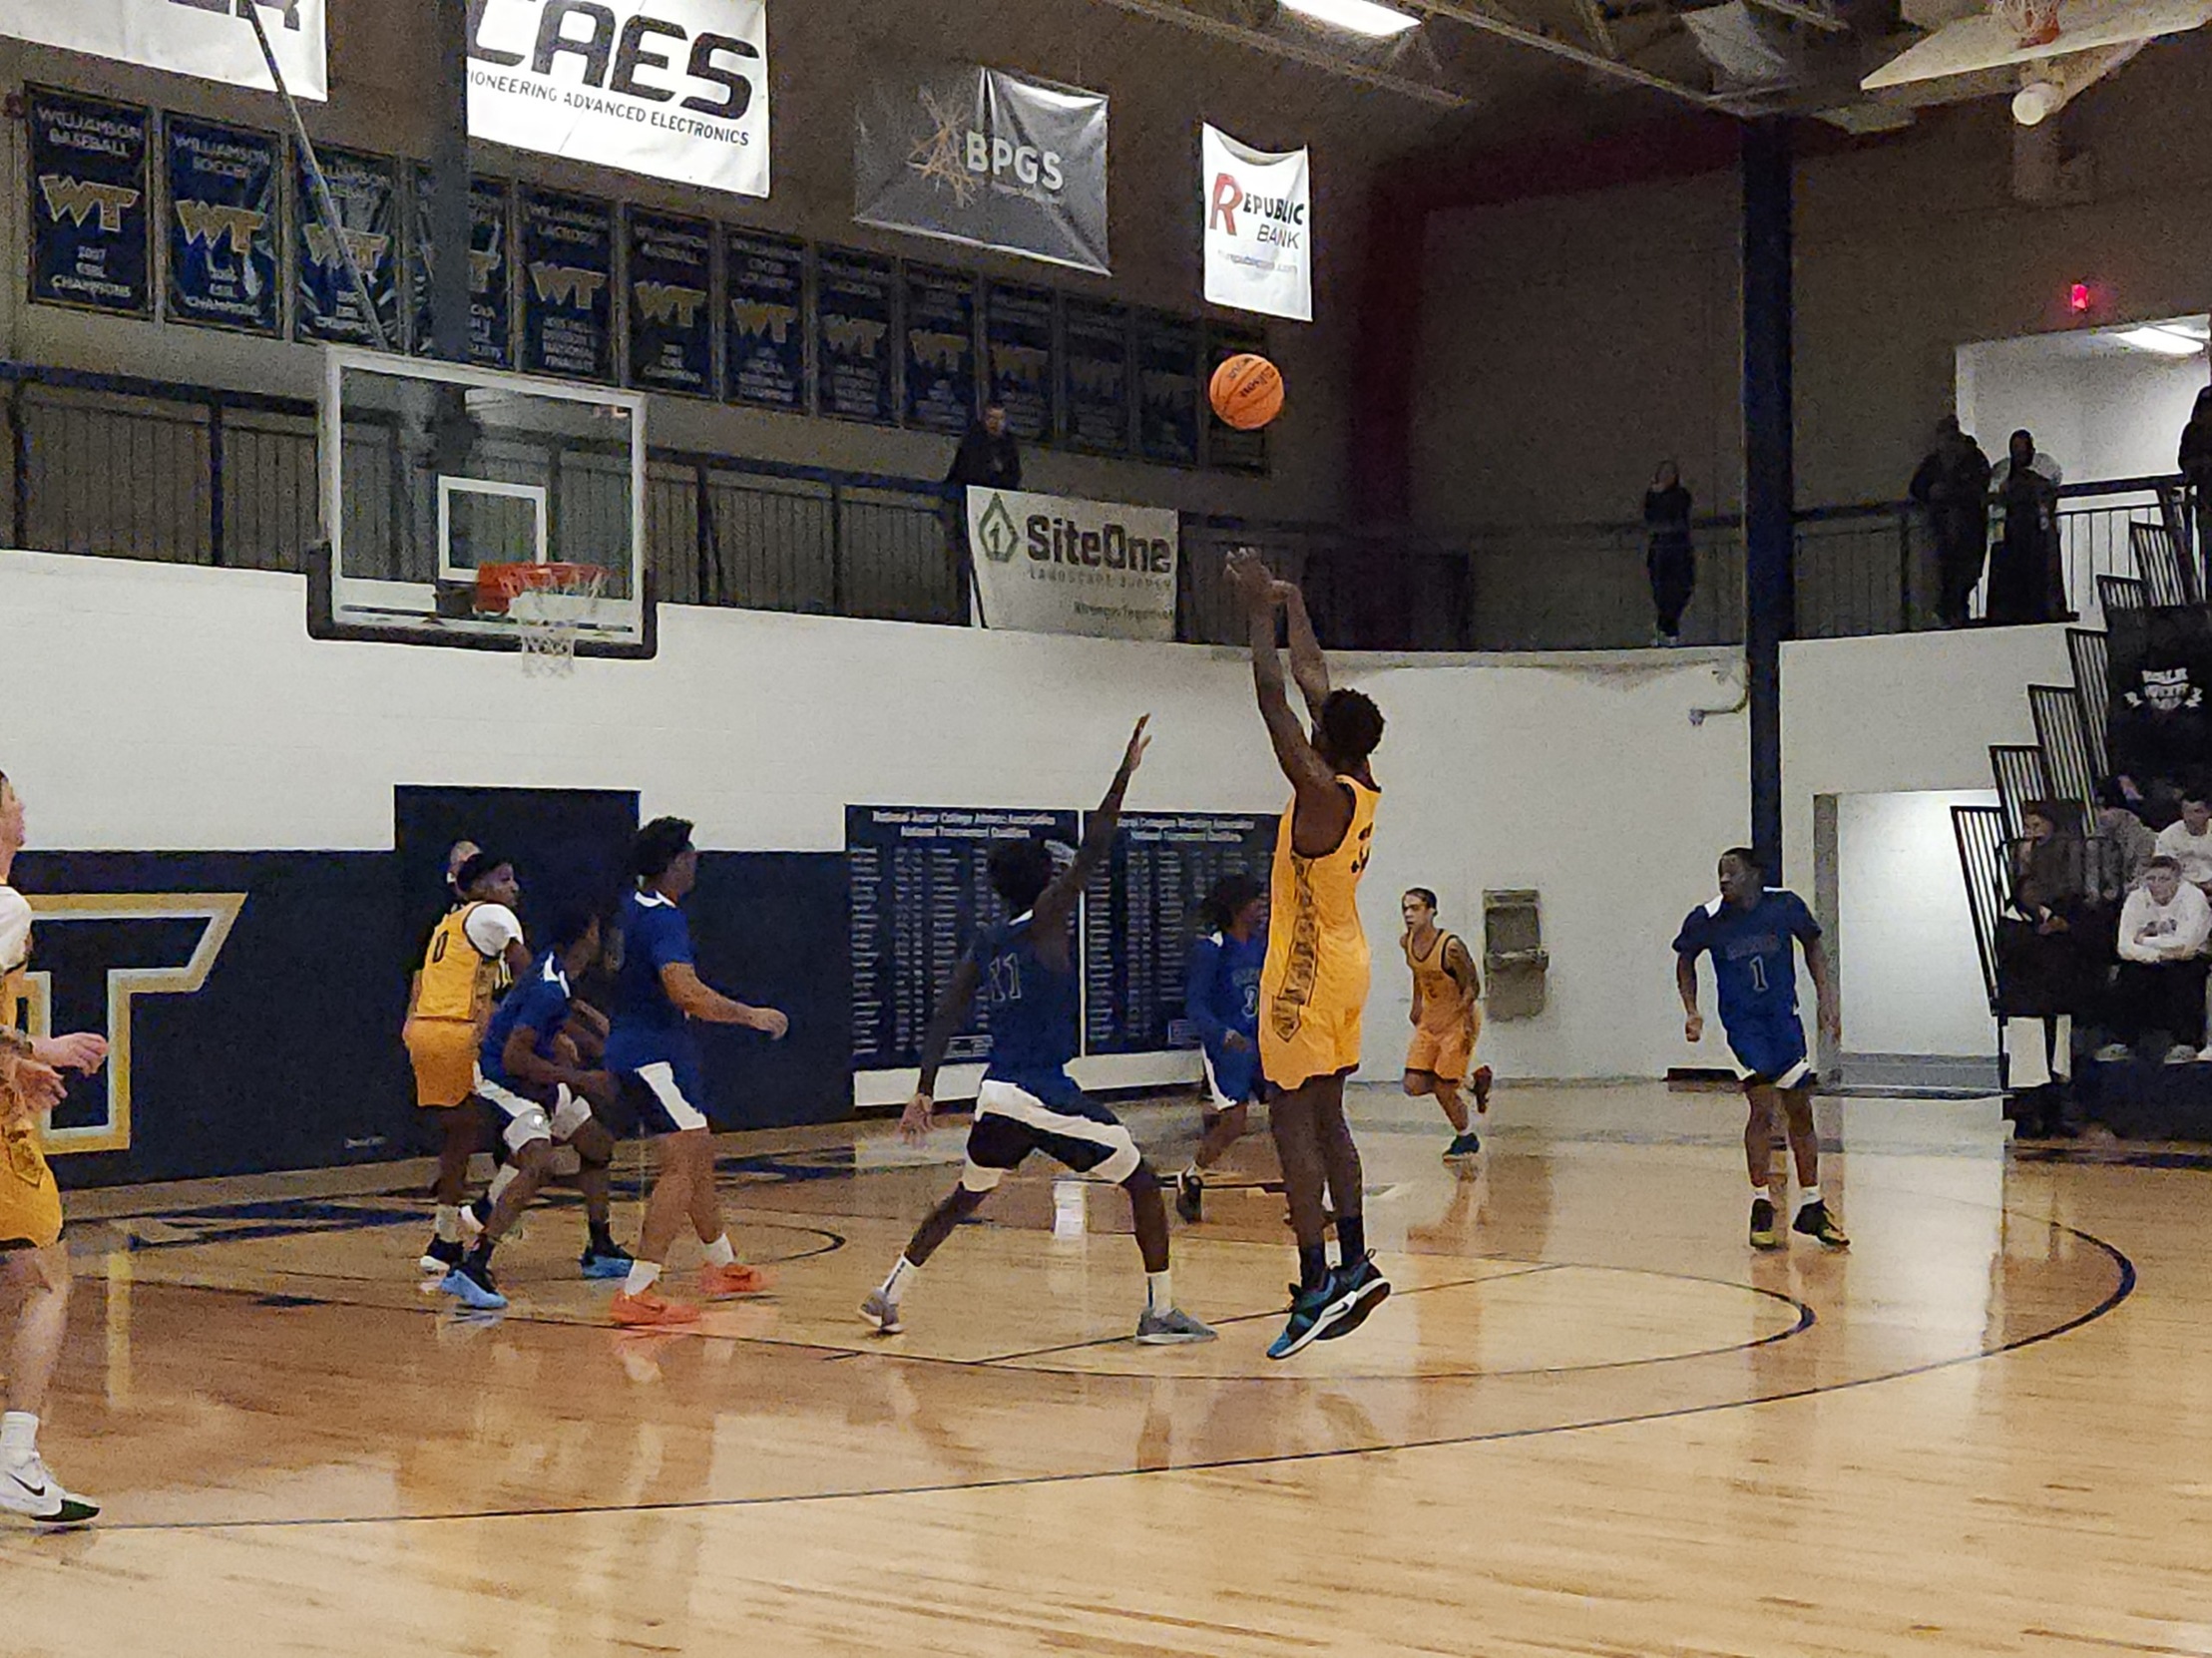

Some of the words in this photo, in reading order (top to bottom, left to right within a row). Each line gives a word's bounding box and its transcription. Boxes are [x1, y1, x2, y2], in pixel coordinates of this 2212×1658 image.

[467, 70, 558, 102] IONEERING
[564, 92, 647, 124] ADVANCED
[650, 111, 750, 147] ELECTRONICS
[966, 130, 1064, 191] BPGS
[39, 175, 141, 231] WT
[175, 200, 265, 254] WT
[1209, 172, 1305, 236] REPUBLIC
[1256, 223, 1301, 250] BANK
[529, 260, 608, 309] WT
[1027, 514, 1172, 574] SiteOne
[432, 930, 450, 964] 0
[1749, 955, 1770, 993] 1
[989, 953, 1022, 1003] 11
